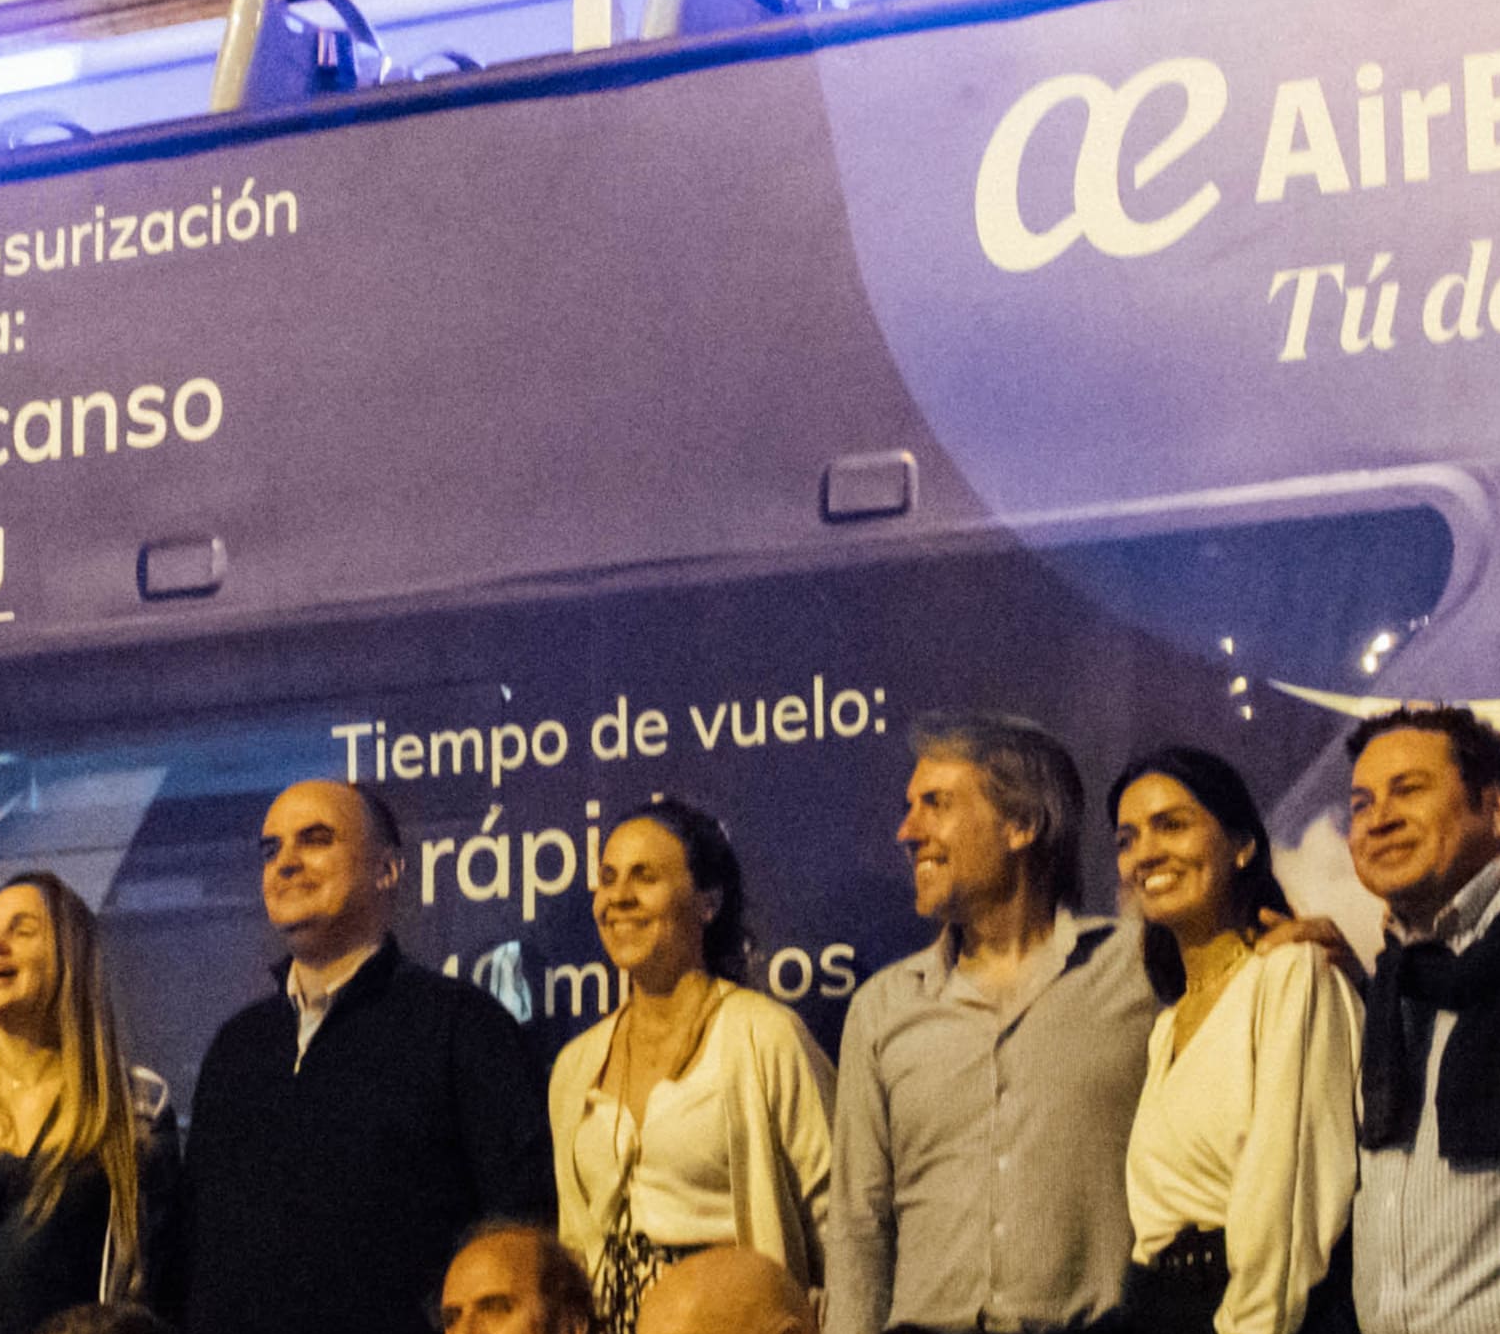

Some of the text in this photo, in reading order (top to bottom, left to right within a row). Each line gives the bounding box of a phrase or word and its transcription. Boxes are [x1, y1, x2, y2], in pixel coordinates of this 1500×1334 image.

[1268, 251, 1399, 362] Tú
[330, 674, 888, 788] Tiempo de vuelo:
